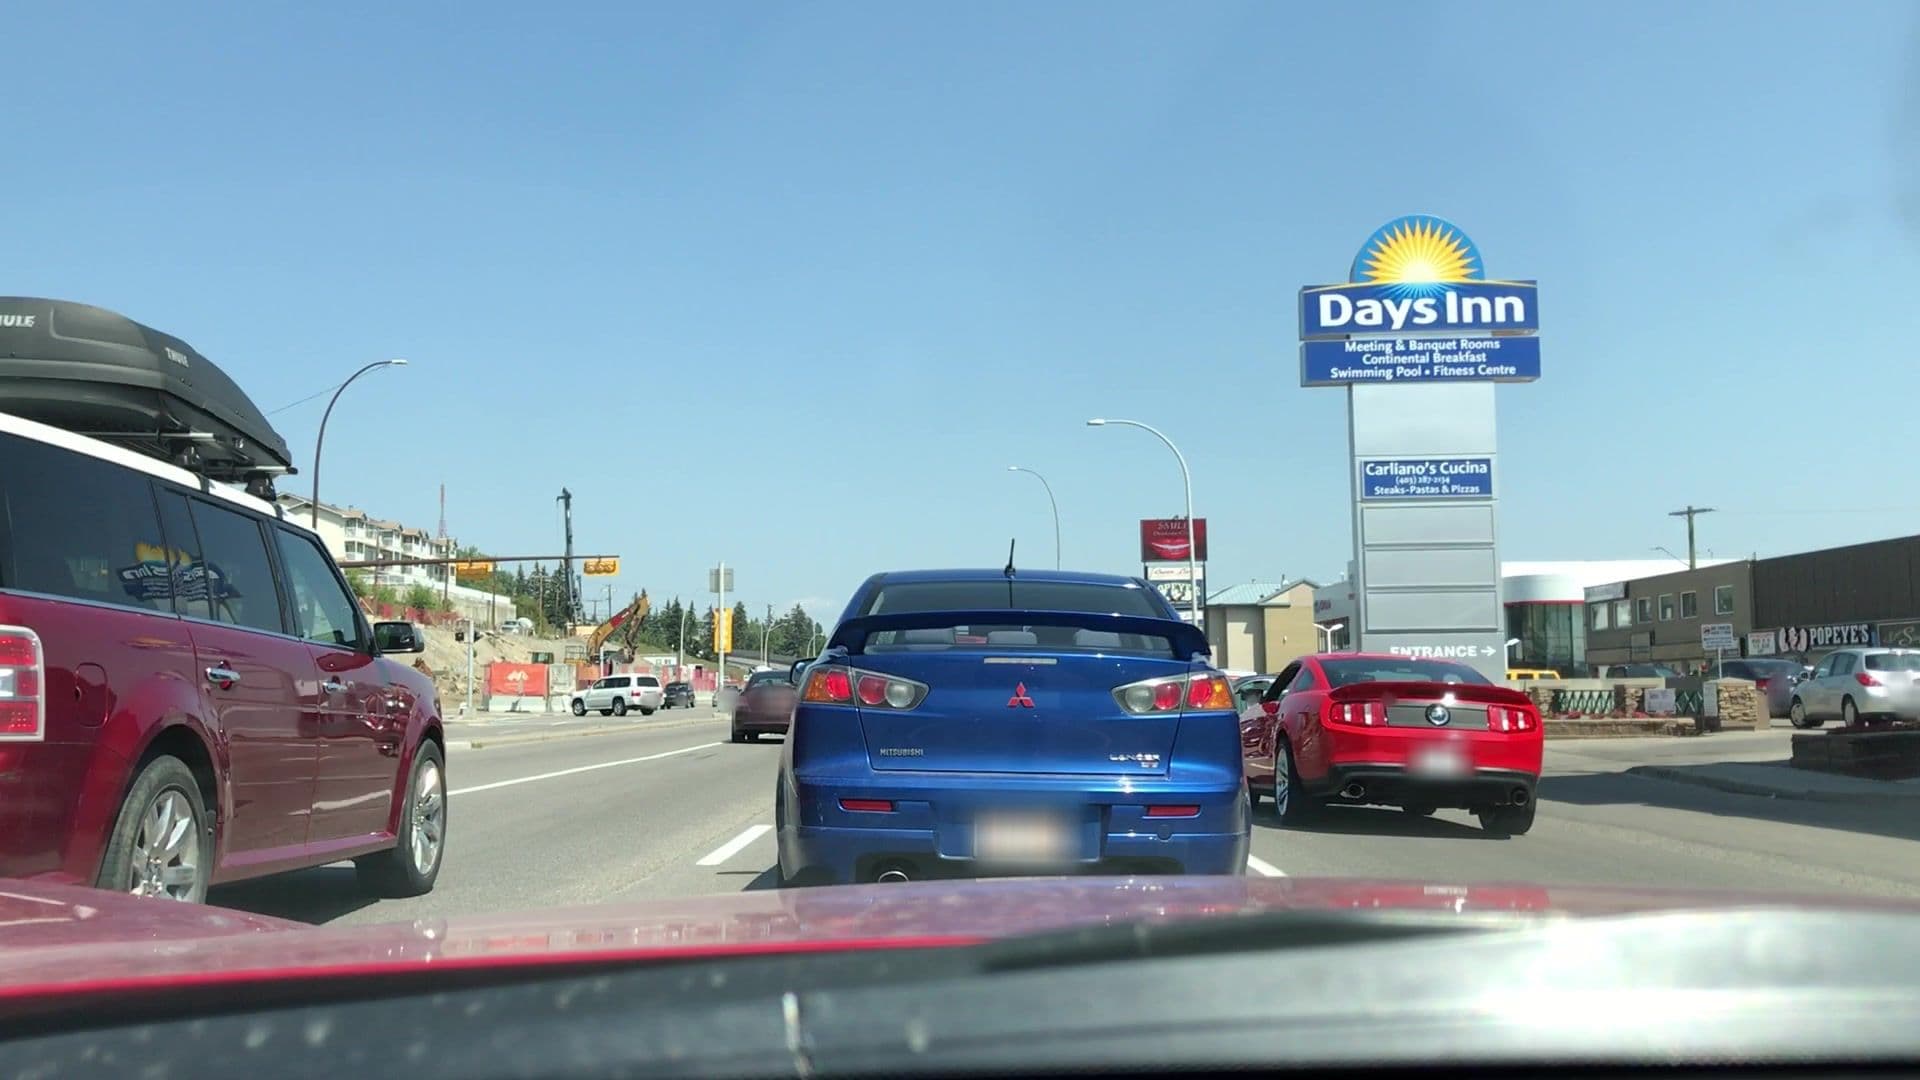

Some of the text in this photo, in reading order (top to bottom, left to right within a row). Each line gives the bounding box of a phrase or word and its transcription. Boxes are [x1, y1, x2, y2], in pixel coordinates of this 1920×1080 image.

[1319, 291, 1525, 330] Days Inn
[0, 315, 36, 327] ULE
[1345, 339, 1500, 354] Meeting & Banquet Rooms
[164, 347, 190, 368] THULE
[1362, 352, 1487, 365] Continental Breakfast
[1330, 363, 1516, 380] Swimming Pool Fitness Centre
[1365, 461, 1488, 476] Carliano's Cucina
[1441, 484, 1450, 493] &
[1451, 483, 1480, 494] Pizzas
[1809, 624, 1869, 646] POPEYE'S
[1390, 646, 1477, 658] ENTRANCE
[880, 748, 924, 756] MITSUBISHI
